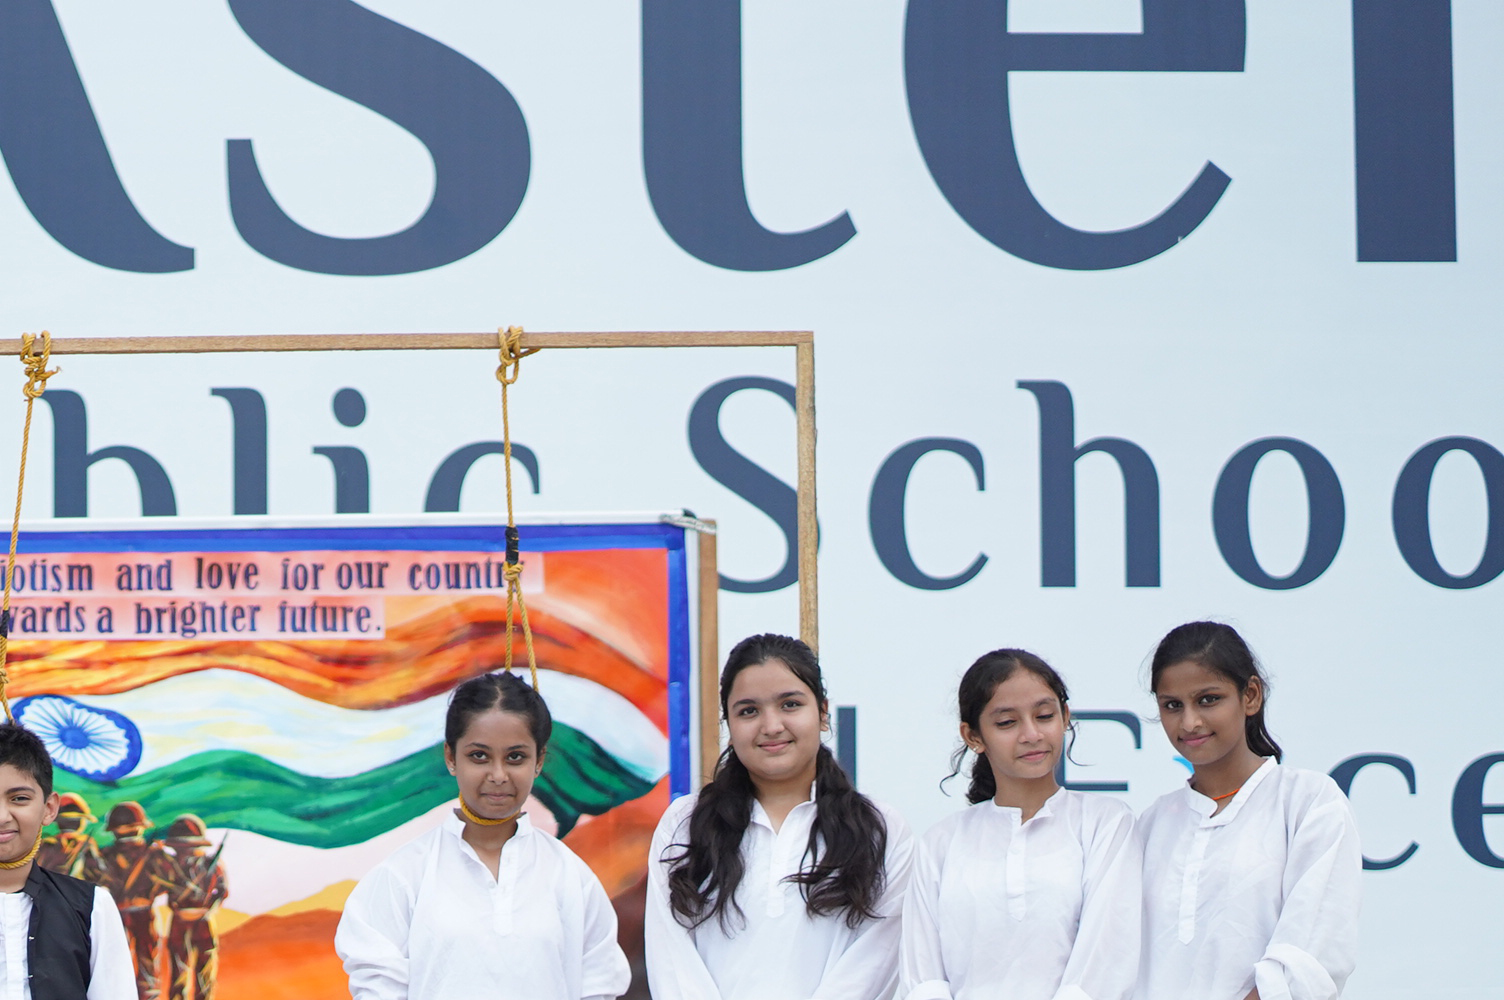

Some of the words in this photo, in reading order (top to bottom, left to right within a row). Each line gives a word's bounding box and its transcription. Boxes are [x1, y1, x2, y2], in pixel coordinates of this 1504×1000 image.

[116, 559, 173, 592] and
[196, 557, 260, 590] love
[281, 558, 325, 591] for
[336, 561, 389, 590] our
[96, 604, 113, 634] a
[134, 599, 261, 638] brighter
[279, 600, 382, 634] future.
